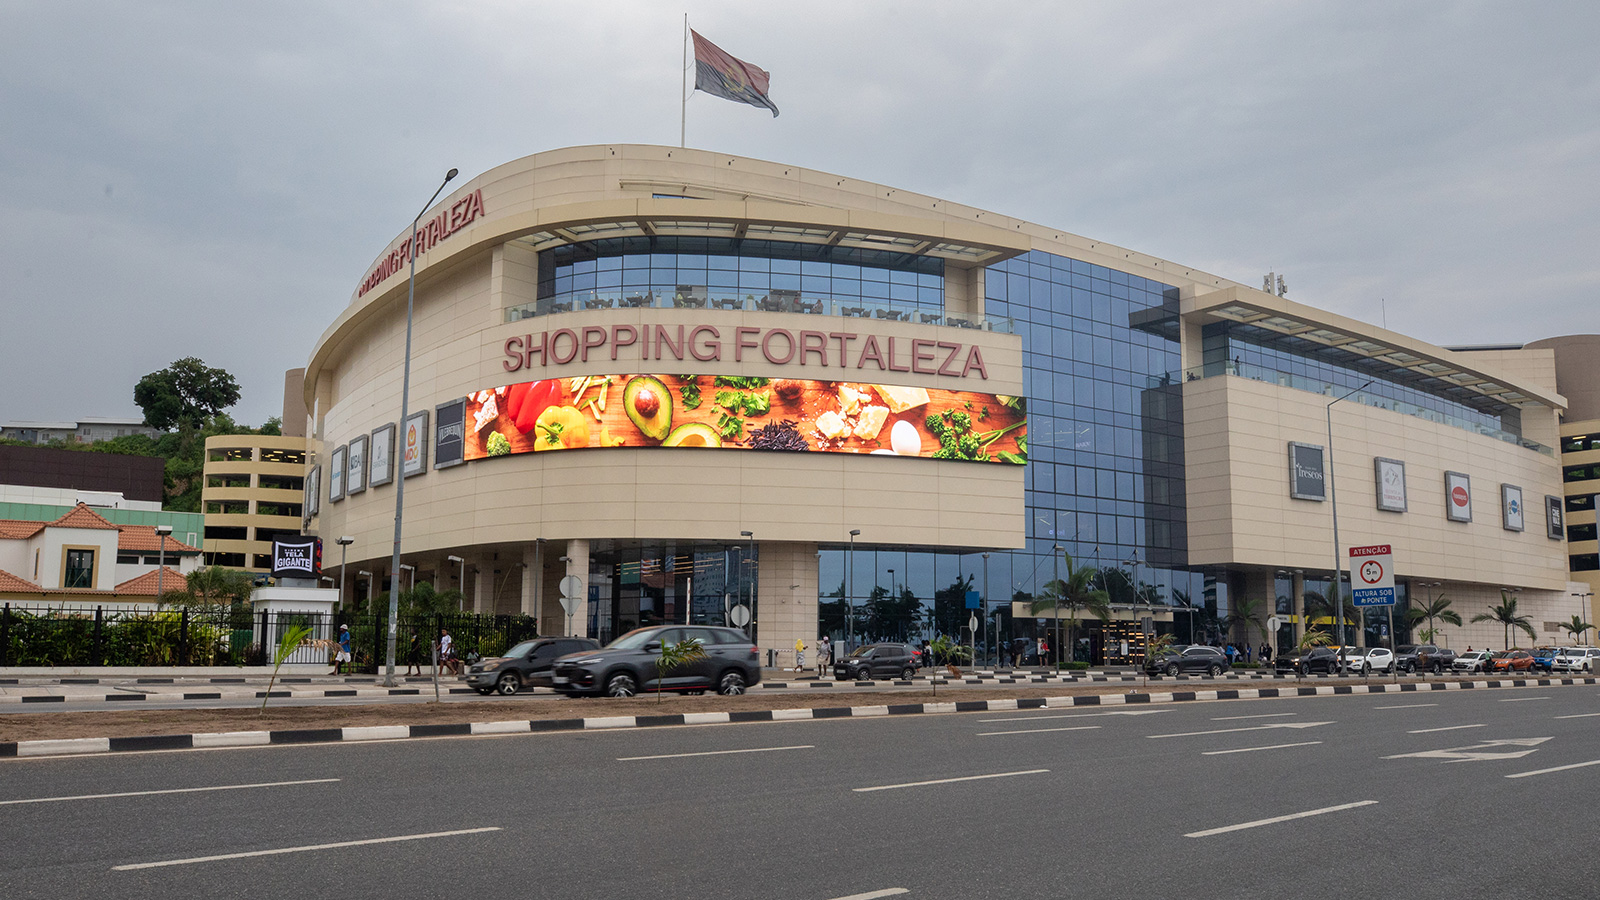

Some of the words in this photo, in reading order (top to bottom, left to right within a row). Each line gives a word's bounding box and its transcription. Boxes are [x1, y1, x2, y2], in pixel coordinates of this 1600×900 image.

[400, 189, 484, 269] FORTALEZA
[503, 324, 722, 372] SHOPPING
[736, 326, 988, 380] FORTALEZA
[277, 558, 310, 568] GIGANTE
[1354, 546, 1387, 555] ATENÇÃO
